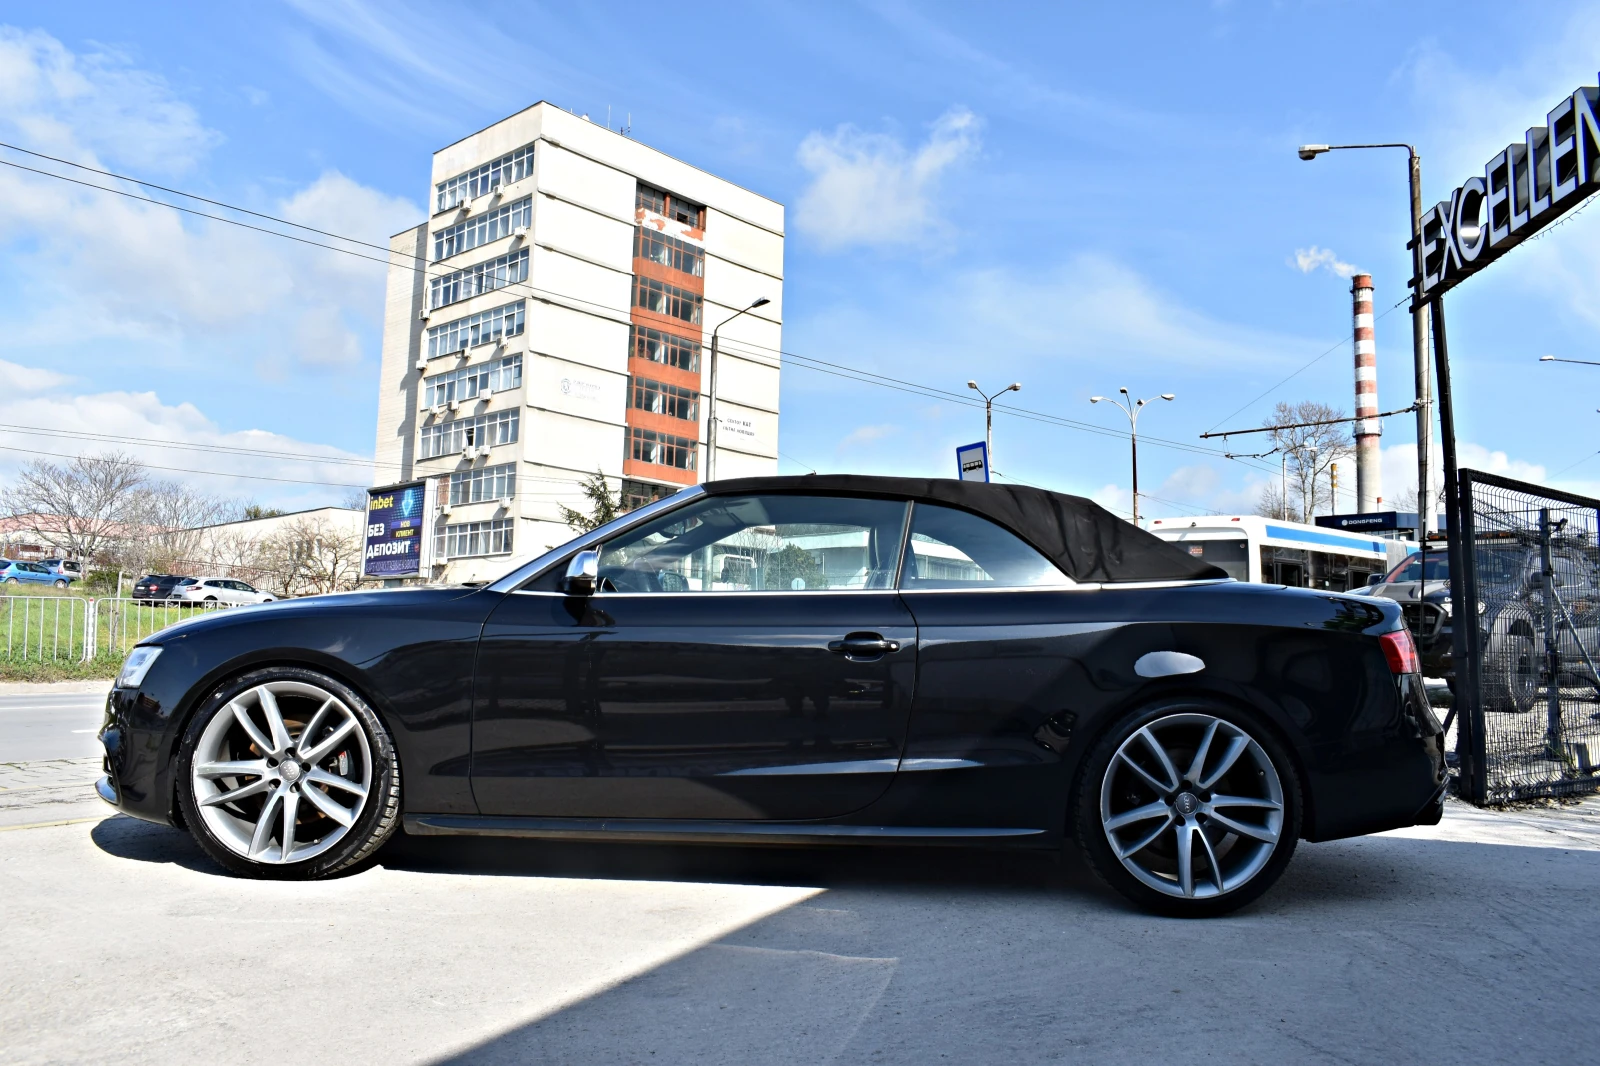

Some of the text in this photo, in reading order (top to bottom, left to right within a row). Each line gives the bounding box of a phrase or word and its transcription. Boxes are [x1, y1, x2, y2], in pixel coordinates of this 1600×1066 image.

[370, 495, 393, 510] inbet
[368, 523, 385, 537] БЕЗ
[366, 541, 411, 560] ДЕПОЗИТ
